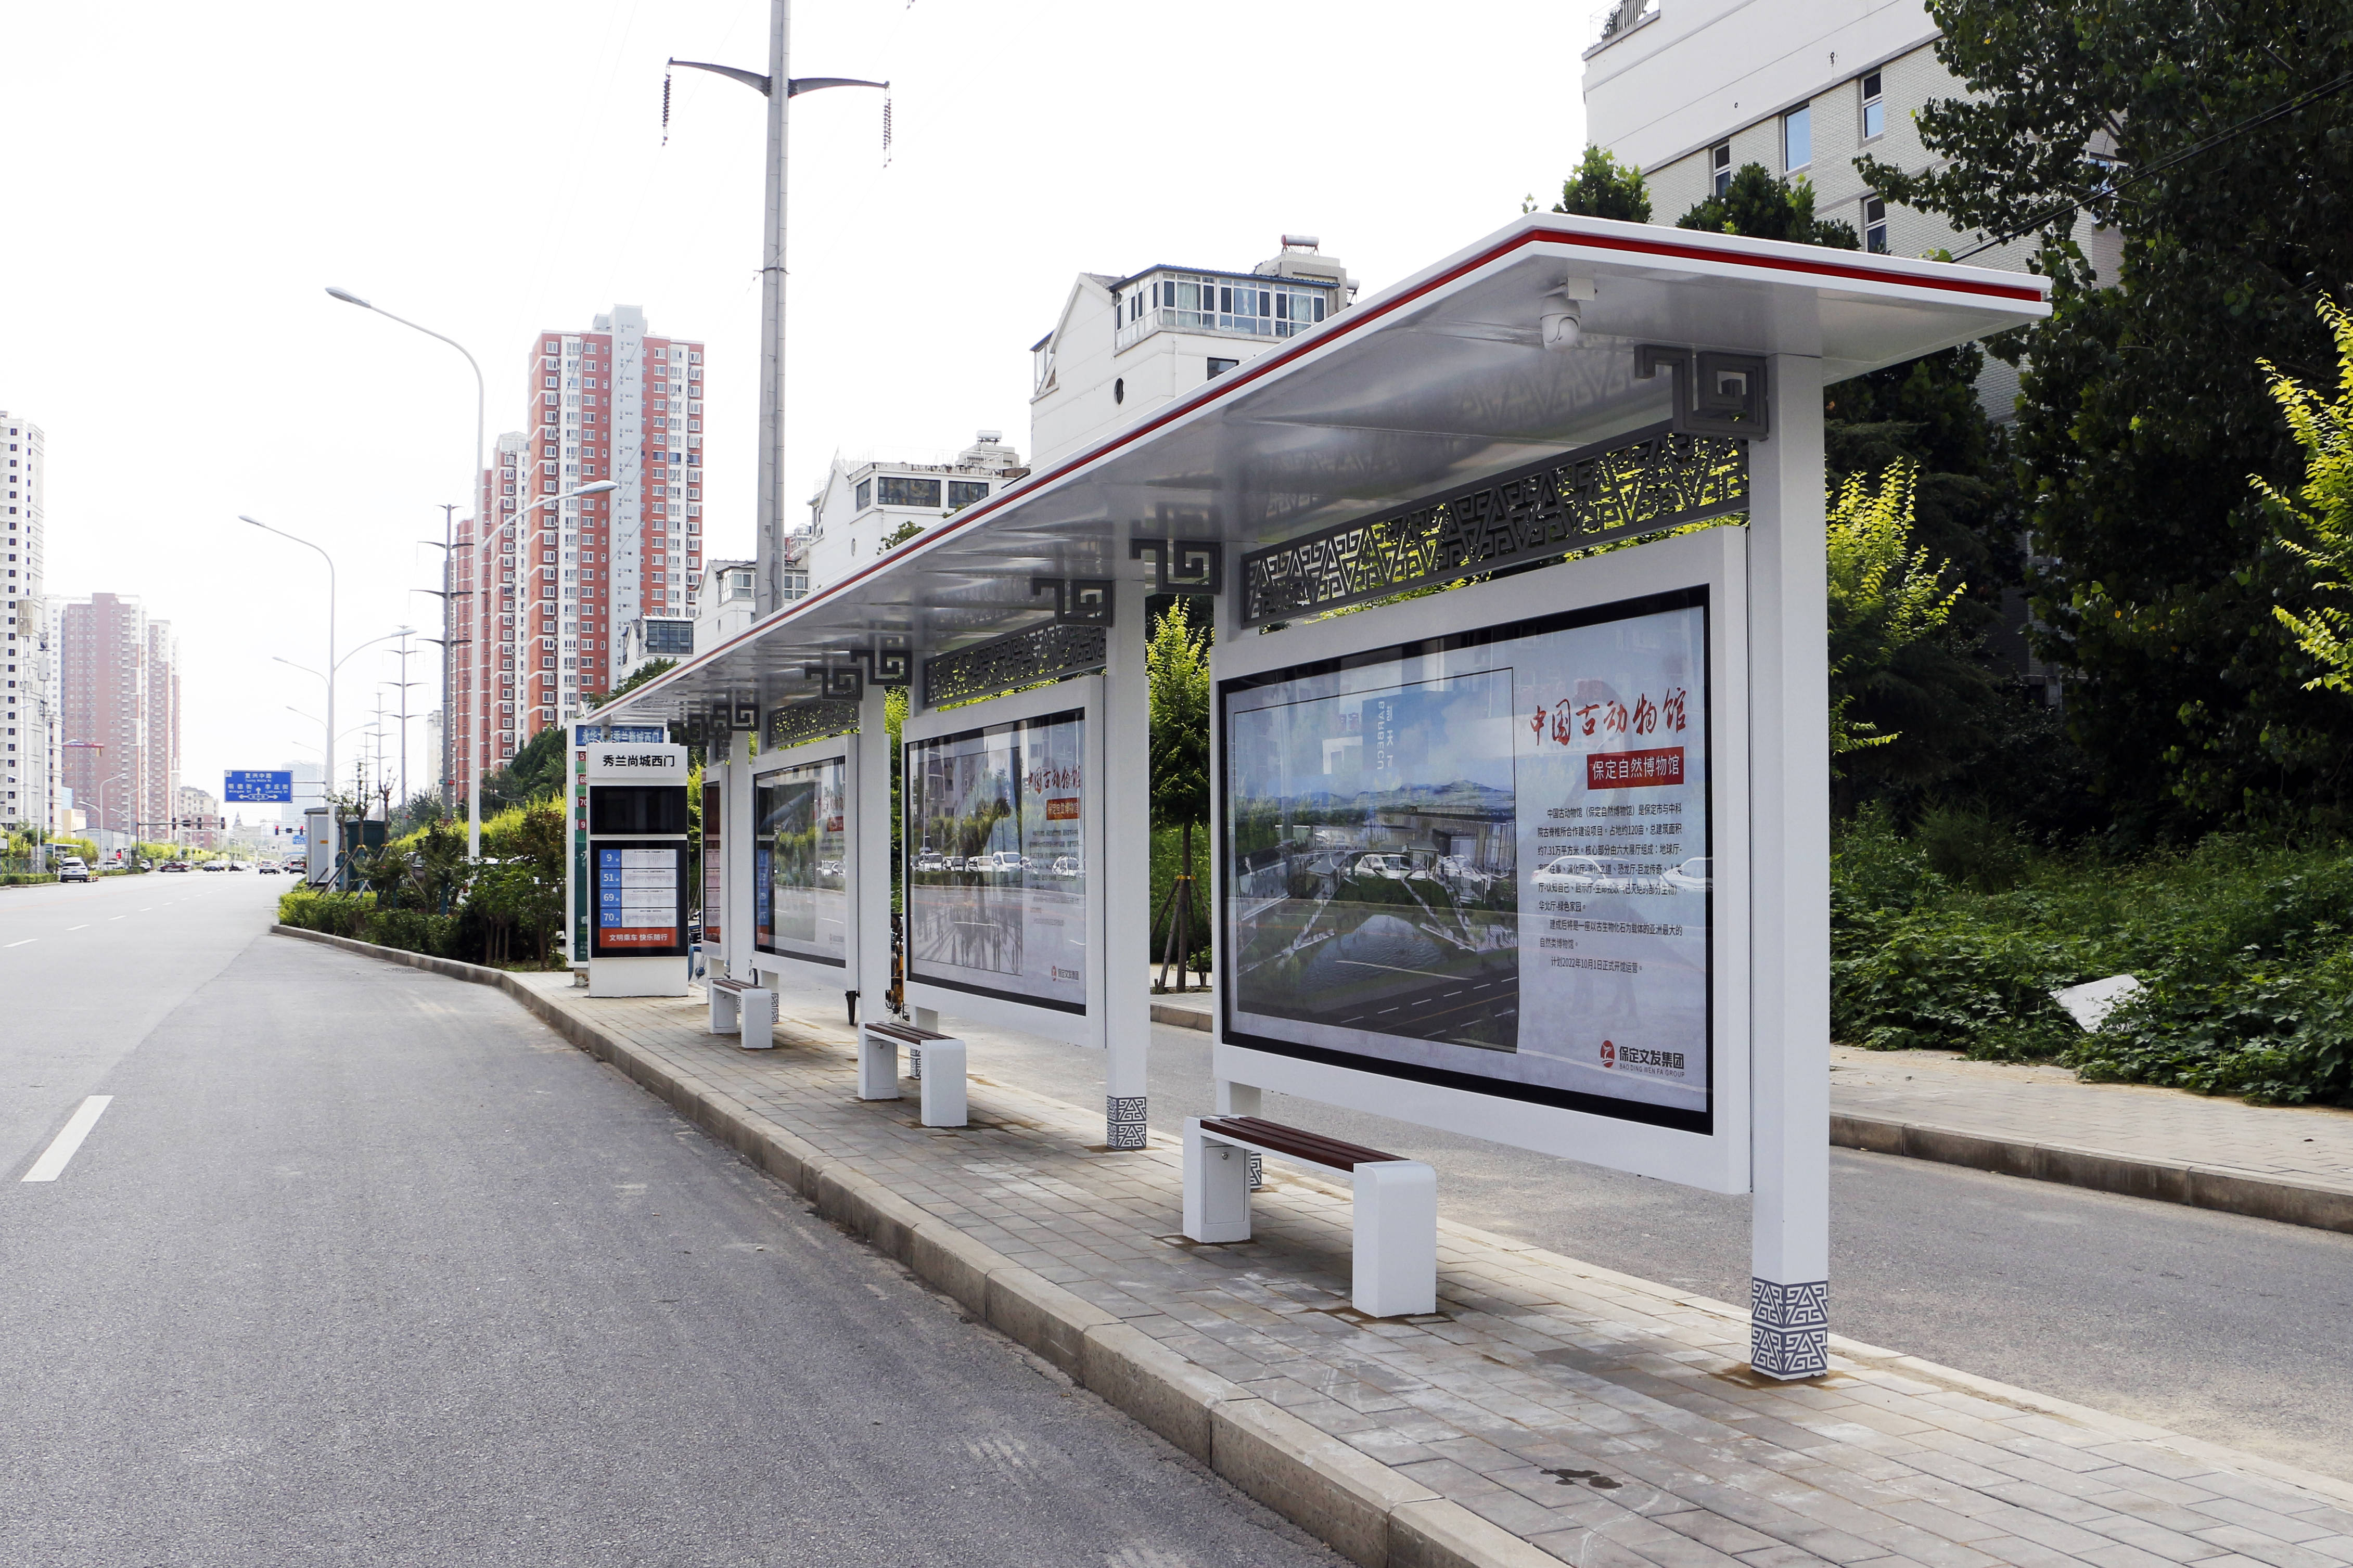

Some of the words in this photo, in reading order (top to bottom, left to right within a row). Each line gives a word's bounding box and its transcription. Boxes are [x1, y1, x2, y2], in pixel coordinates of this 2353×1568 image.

[1530, 687, 1686, 746] 中国古动物馆
[603, 755, 675, 767] 秀兰尚城西门
[1592, 754, 1680, 780] 保定自然博物馆
[603, 893, 615, 902] 69
[1550, 920, 1682, 936] 建成后将是一座以古生物化石为载体的亚洲最大的
[1540, 937, 1578, 949] 自然类博物馆。
[1551, 957, 1643, 973] 计划2022年10月1日正式开馆运营。
[1619, 1046, 1684, 1069] 保定文发集团
